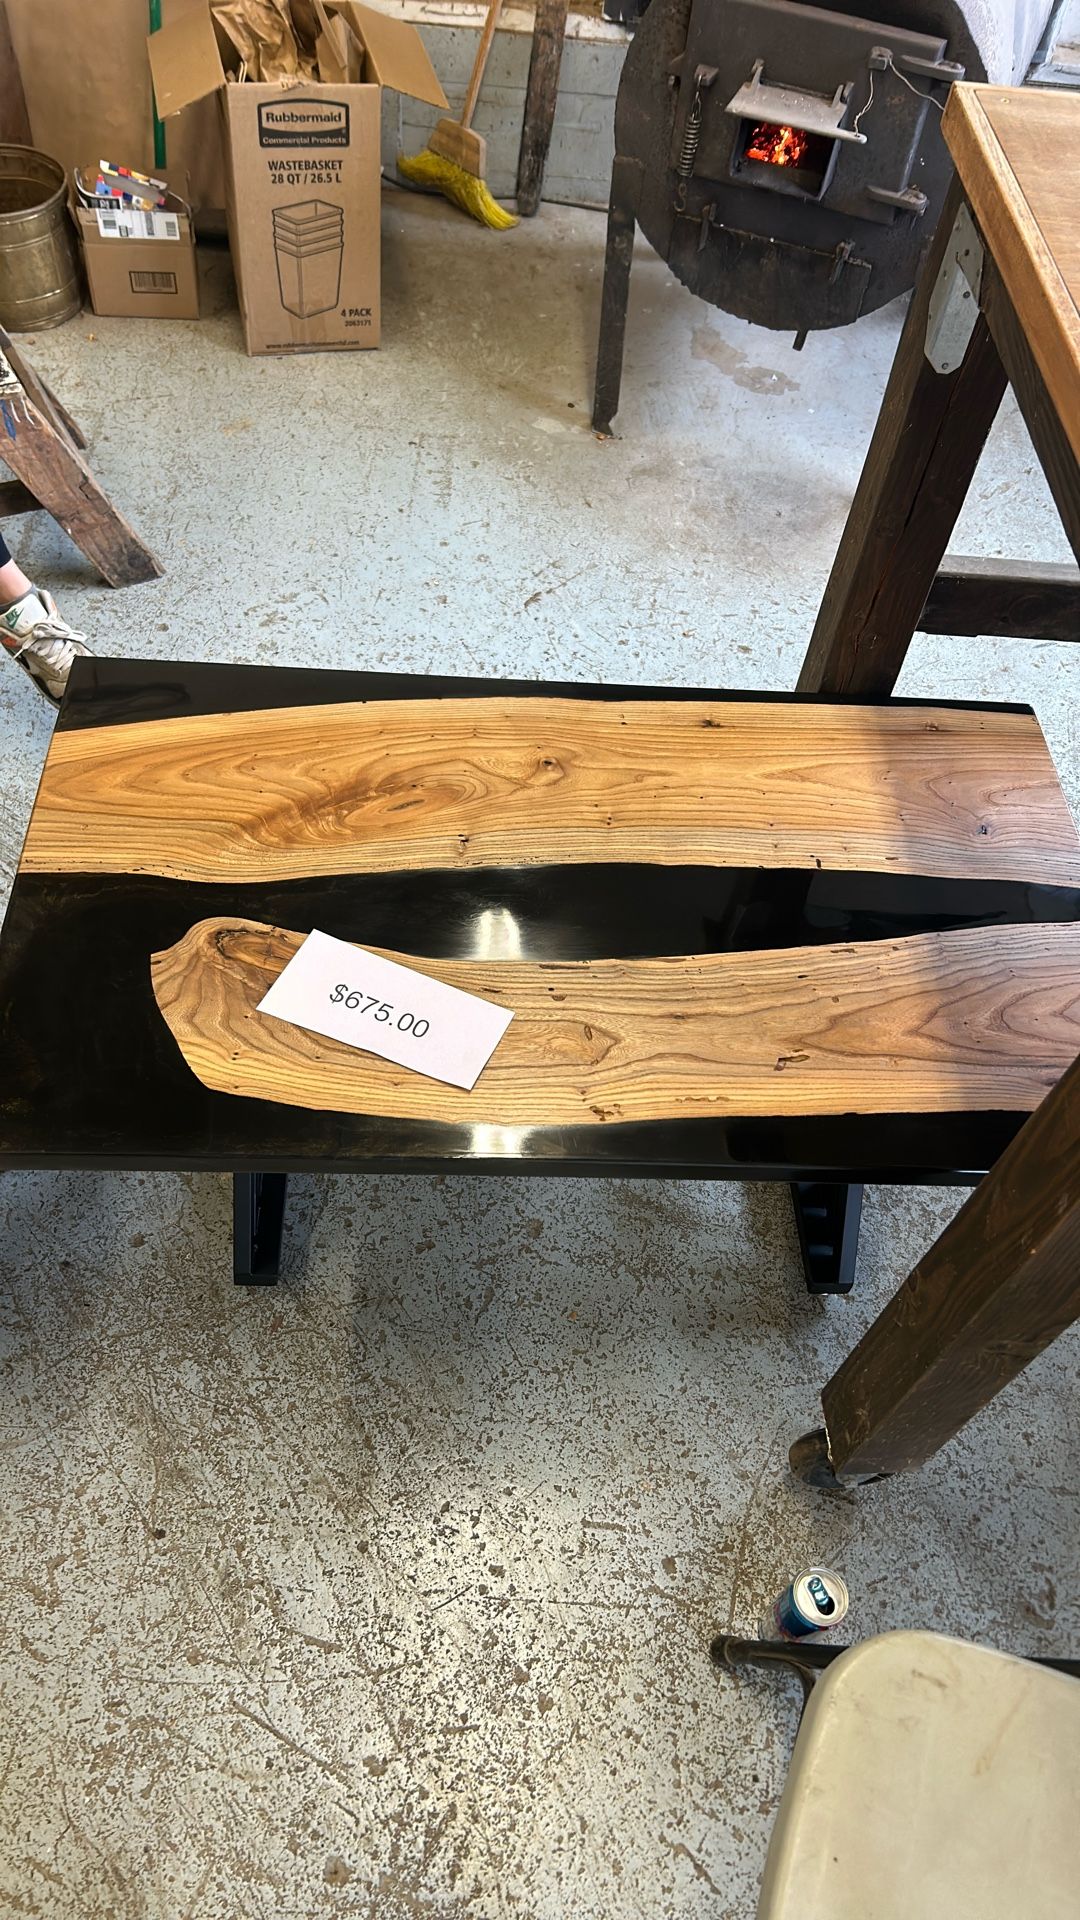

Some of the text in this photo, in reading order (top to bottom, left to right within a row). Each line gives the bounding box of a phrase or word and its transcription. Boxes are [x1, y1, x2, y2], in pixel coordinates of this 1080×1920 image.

[266, 112, 342, 123] Rubbermaid
[262, 136, 346, 145] Commercial Products
[268, 160, 343, 171] WASTEBASKET
[271, 174, 283, 184] 28
[287, 174, 302, 185] QT
[310, 173, 333, 184] 26.5
[335, 173, 342, 183] L
[341, 308, 372, 317] 4 PACK
[329, 984, 430, 1038] $675.00
